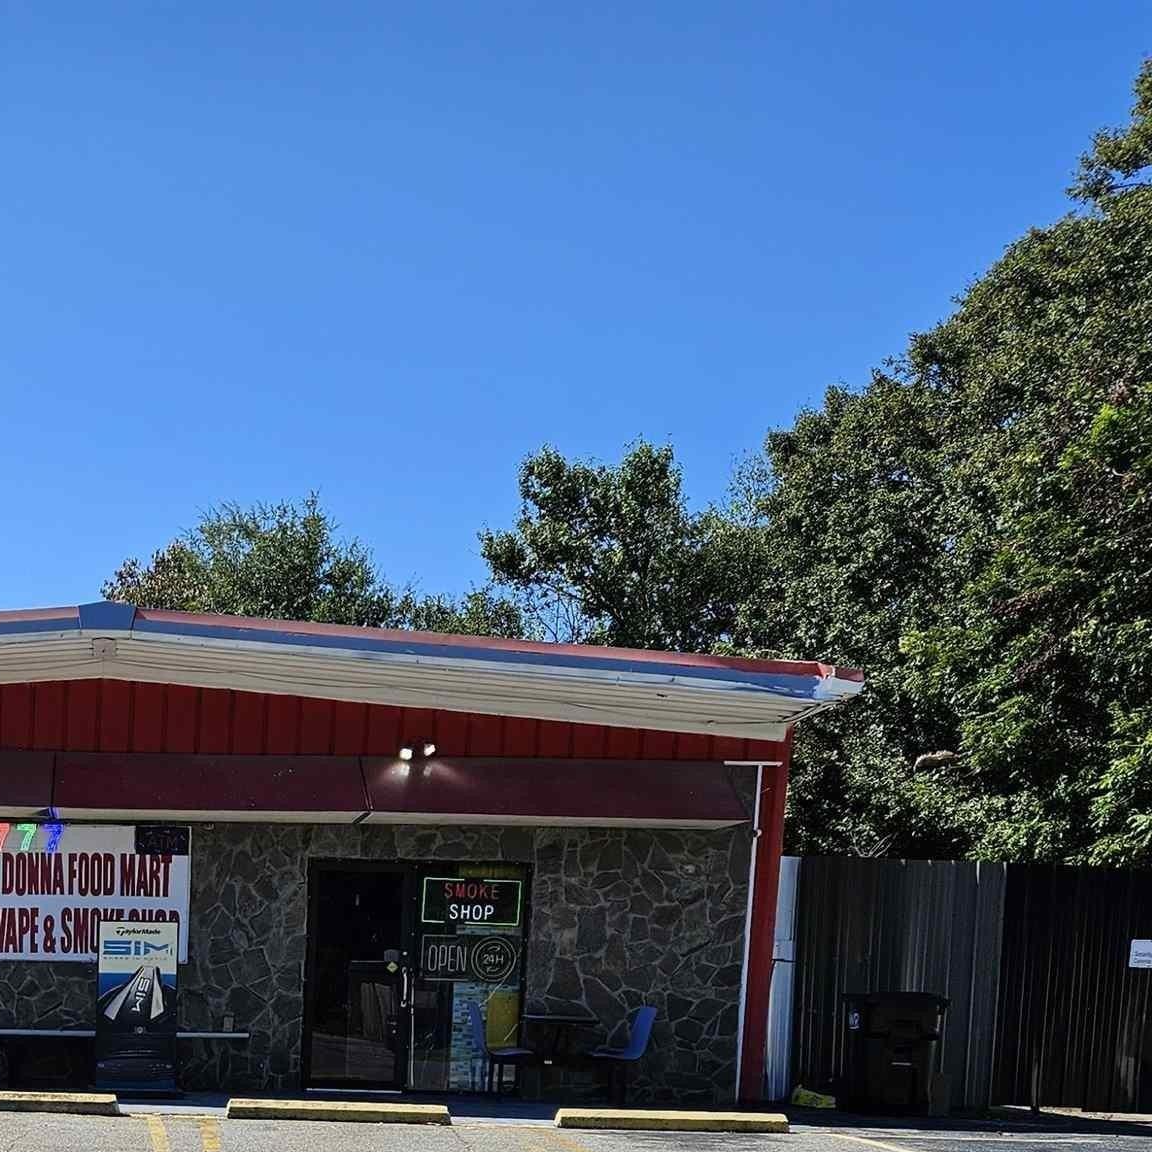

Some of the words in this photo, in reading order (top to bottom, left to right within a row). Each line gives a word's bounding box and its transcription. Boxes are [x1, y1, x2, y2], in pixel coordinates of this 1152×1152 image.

[1, 852, 65, 897] DONNA
[68, 853, 115, 897] FOOD
[120, 853, 173, 898] MART
[443, 882, 499, 899] SMOKE
[449, 904, 495, 921] SHOP
[42, 914, 56, 954] &
[60, 906, 125, 955] SMO
[427, 945, 467, 972] OPEN
[482, 953, 505, 965] 24H
